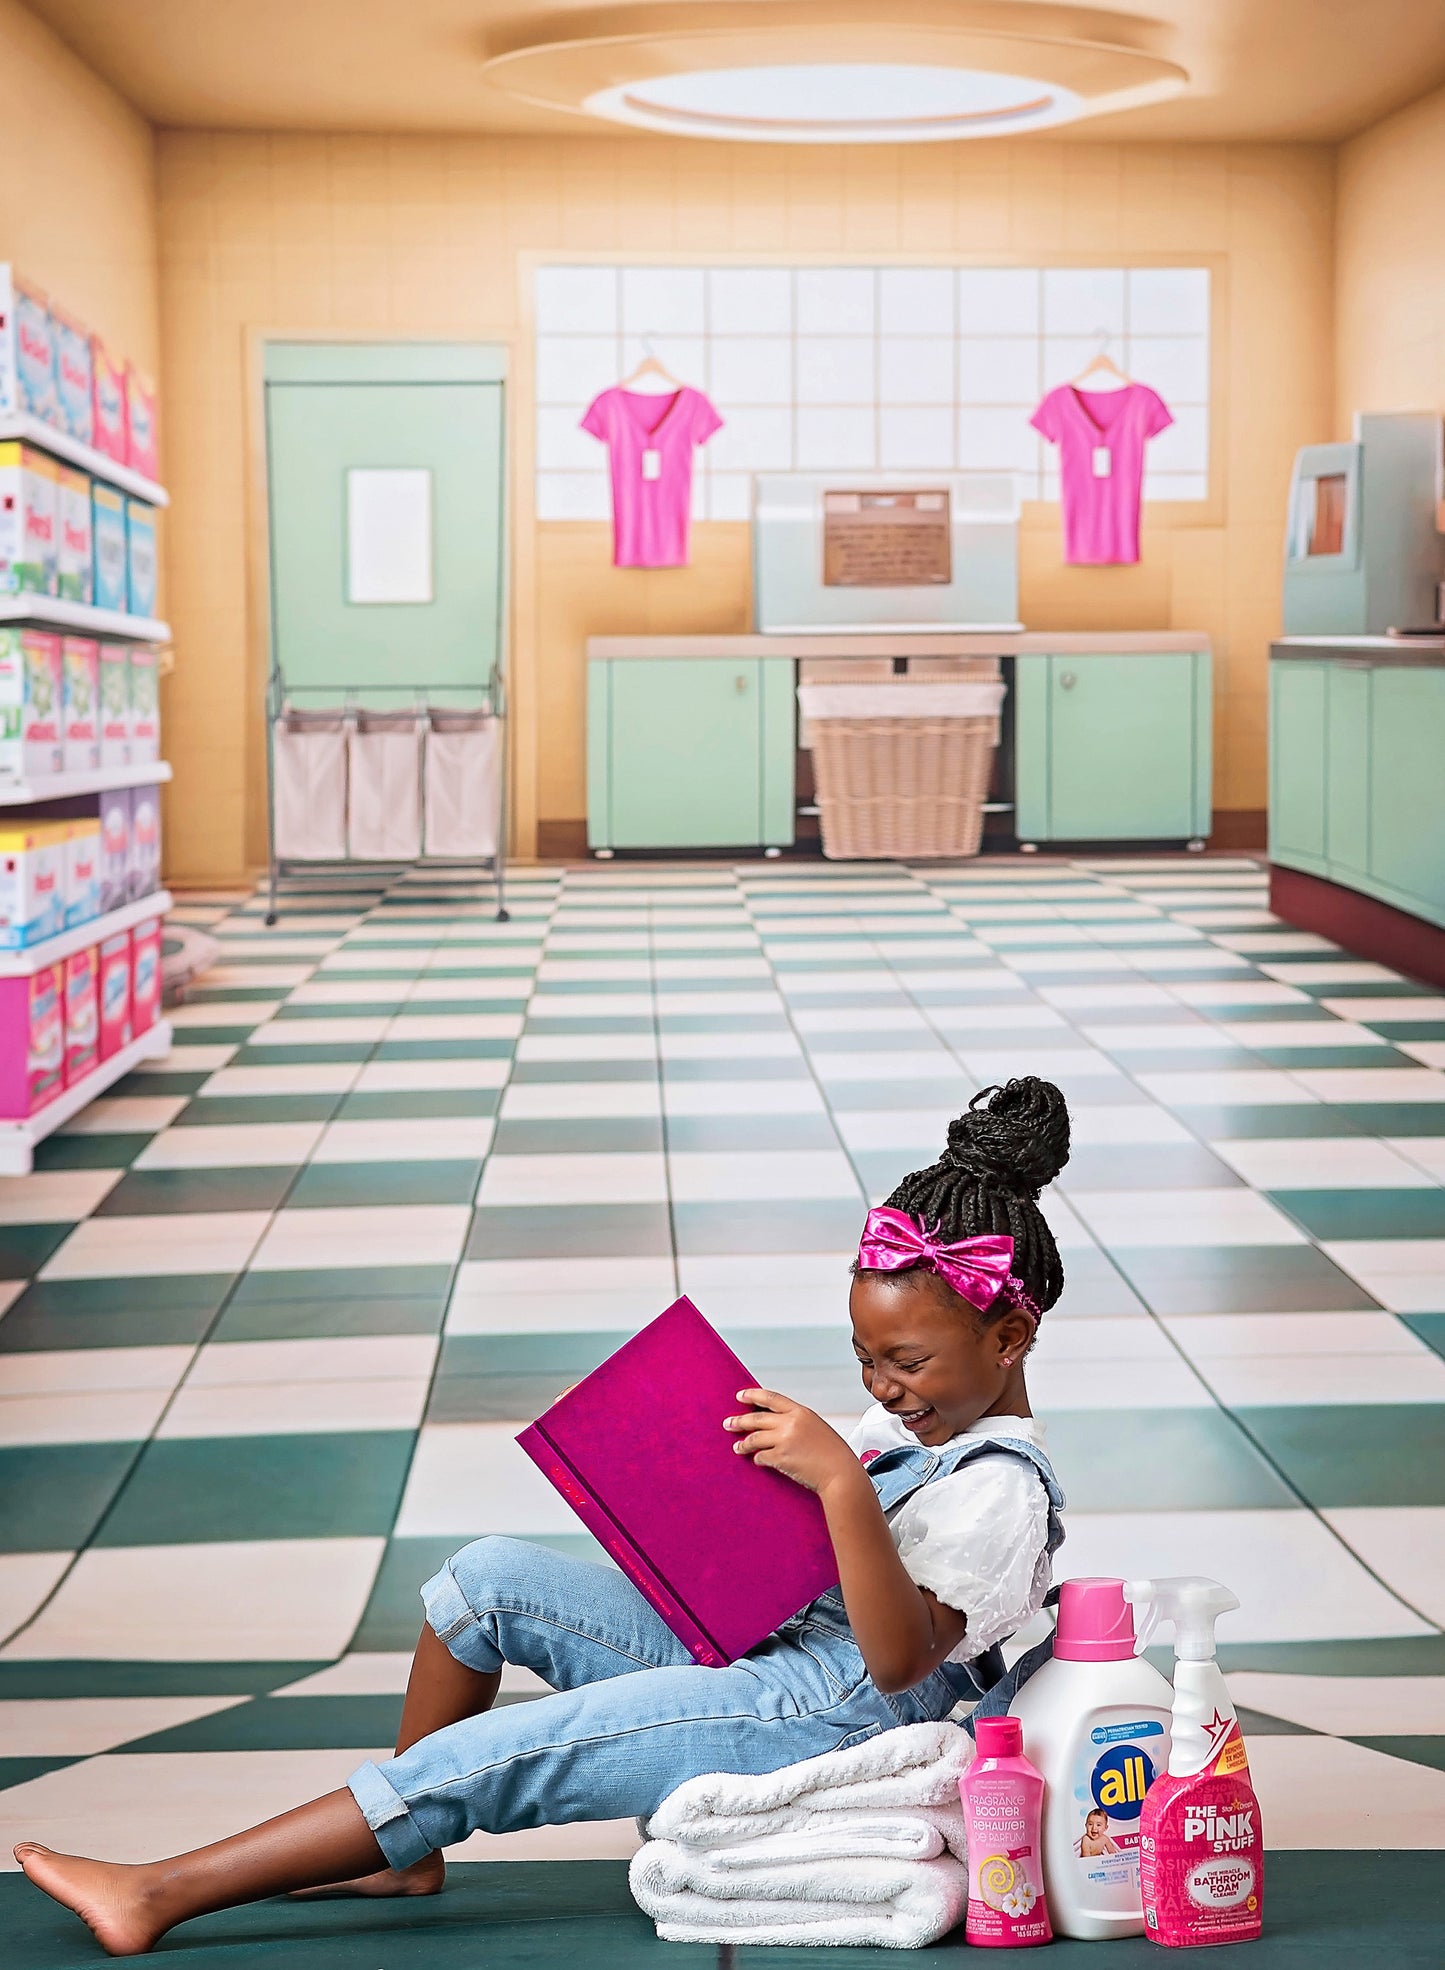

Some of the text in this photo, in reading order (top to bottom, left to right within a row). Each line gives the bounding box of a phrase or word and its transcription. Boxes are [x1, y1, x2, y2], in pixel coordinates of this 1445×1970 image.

[1099, 1756, 1146, 1806] all
[969, 1794, 1026, 1806] FRAGRANCE
[975, 1806, 1020, 1817] BOOSTER
[1185, 1805, 1217, 1818] THE
[973, 1820, 1026, 1831] REHAUSSER
[1184, 1811, 1253, 1842] PINK
[989, 1832, 1026, 1842] PARFUM
[1213, 1835, 1254, 1853] STUFF
[1219, 1867, 1241, 1875] MIRACLE
[1194, 1870, 1251, 1886] BATHROOM
[1210, 1882, 1240, 1894] FOAM
